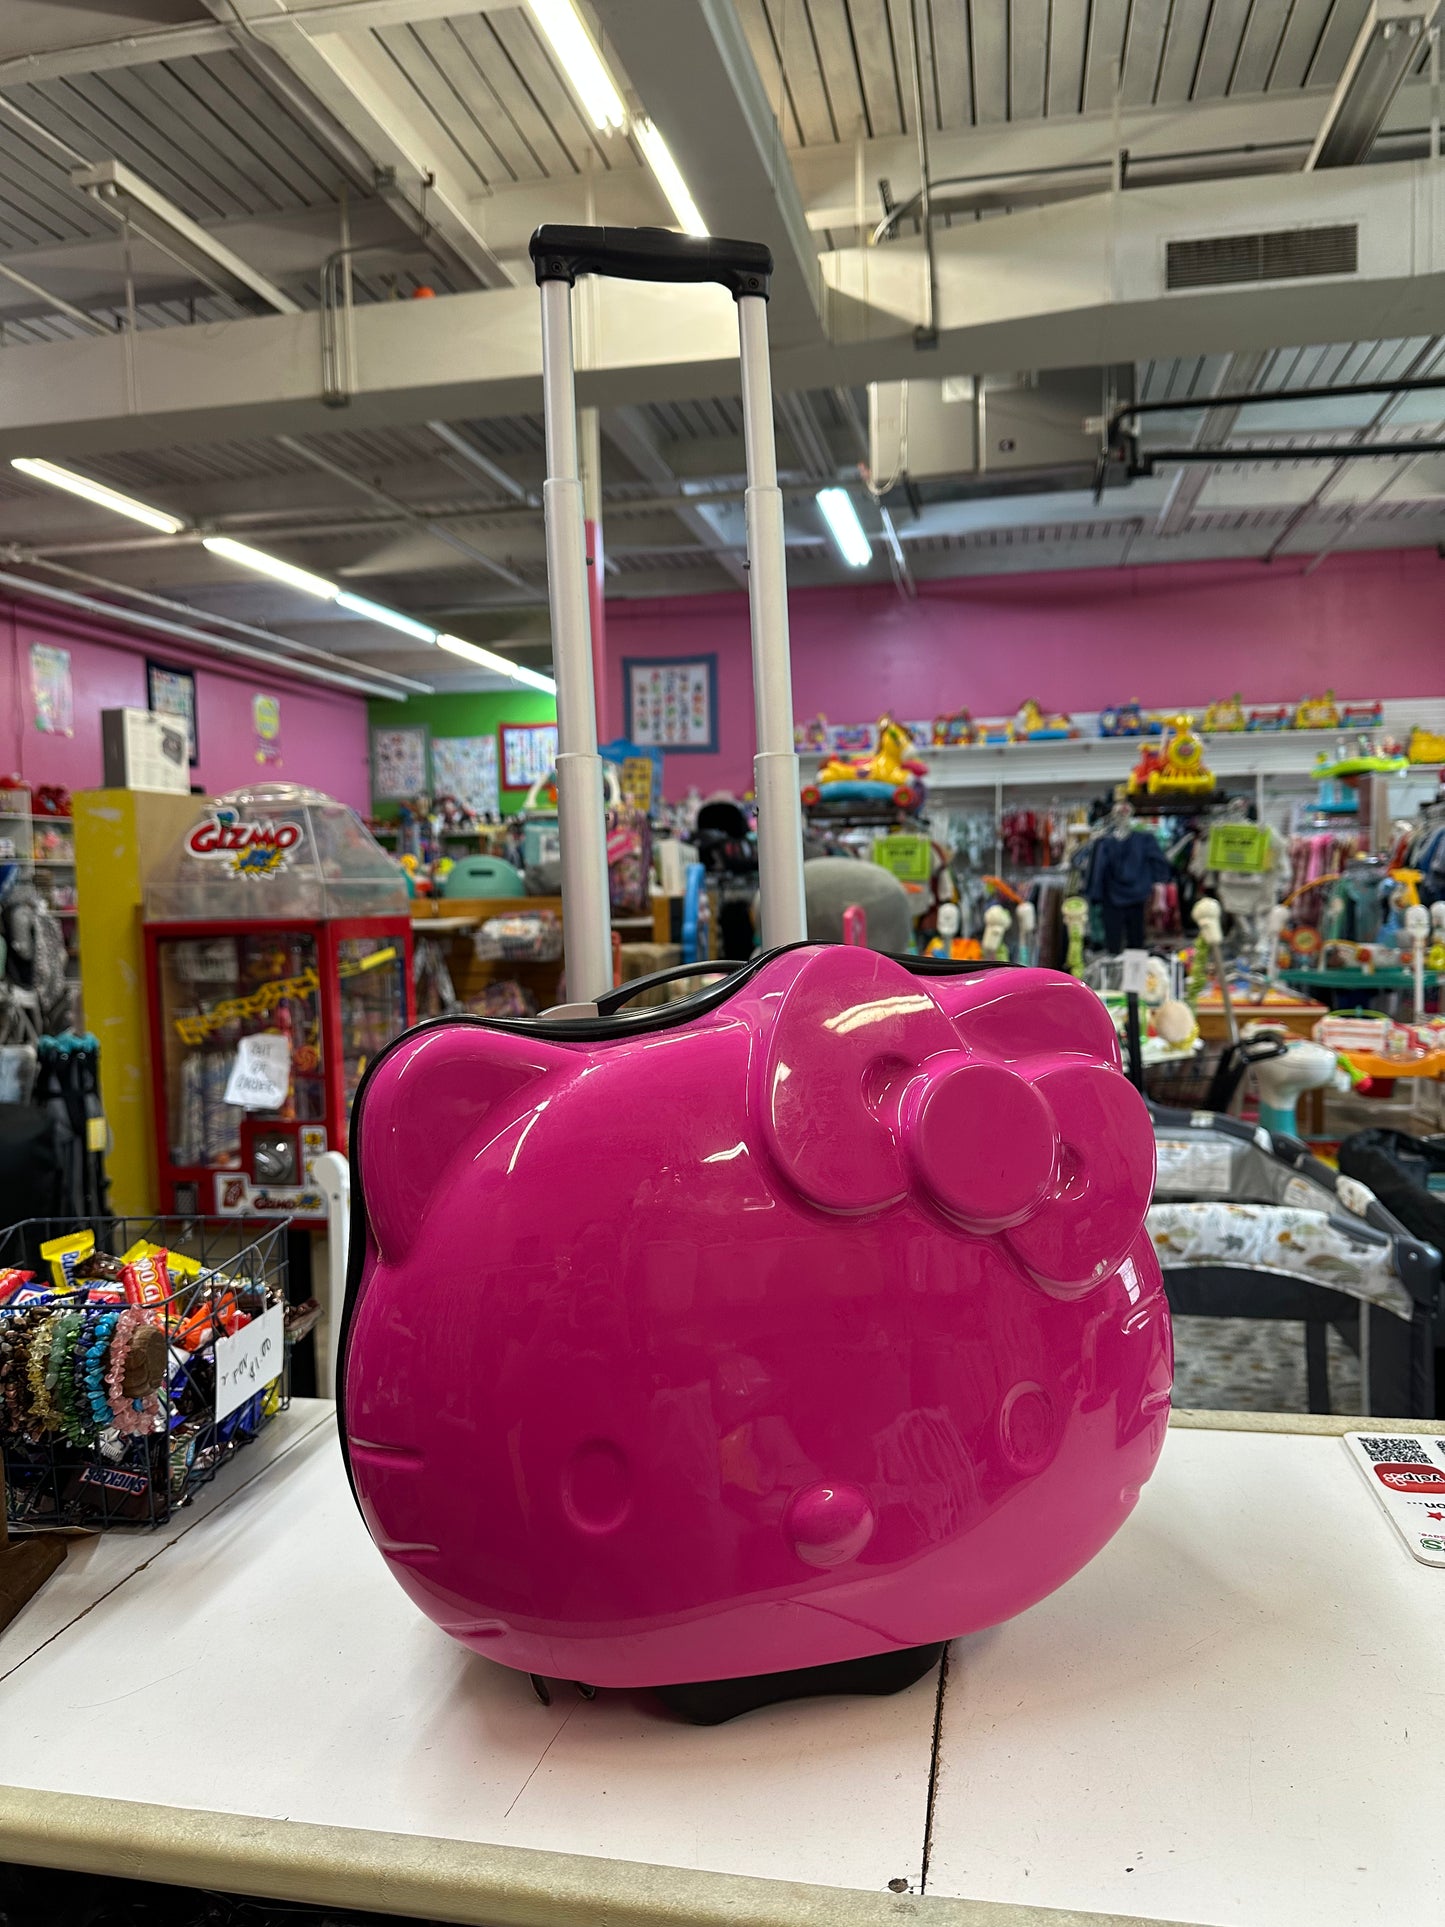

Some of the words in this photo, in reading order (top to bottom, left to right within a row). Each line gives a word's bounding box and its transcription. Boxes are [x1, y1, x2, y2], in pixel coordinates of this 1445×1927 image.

[189, 820, 298, 852] GIZMO
[84, 1467, 146, 1494] SNICKERS
[1402, 1472, 1445, 1484] yelp
